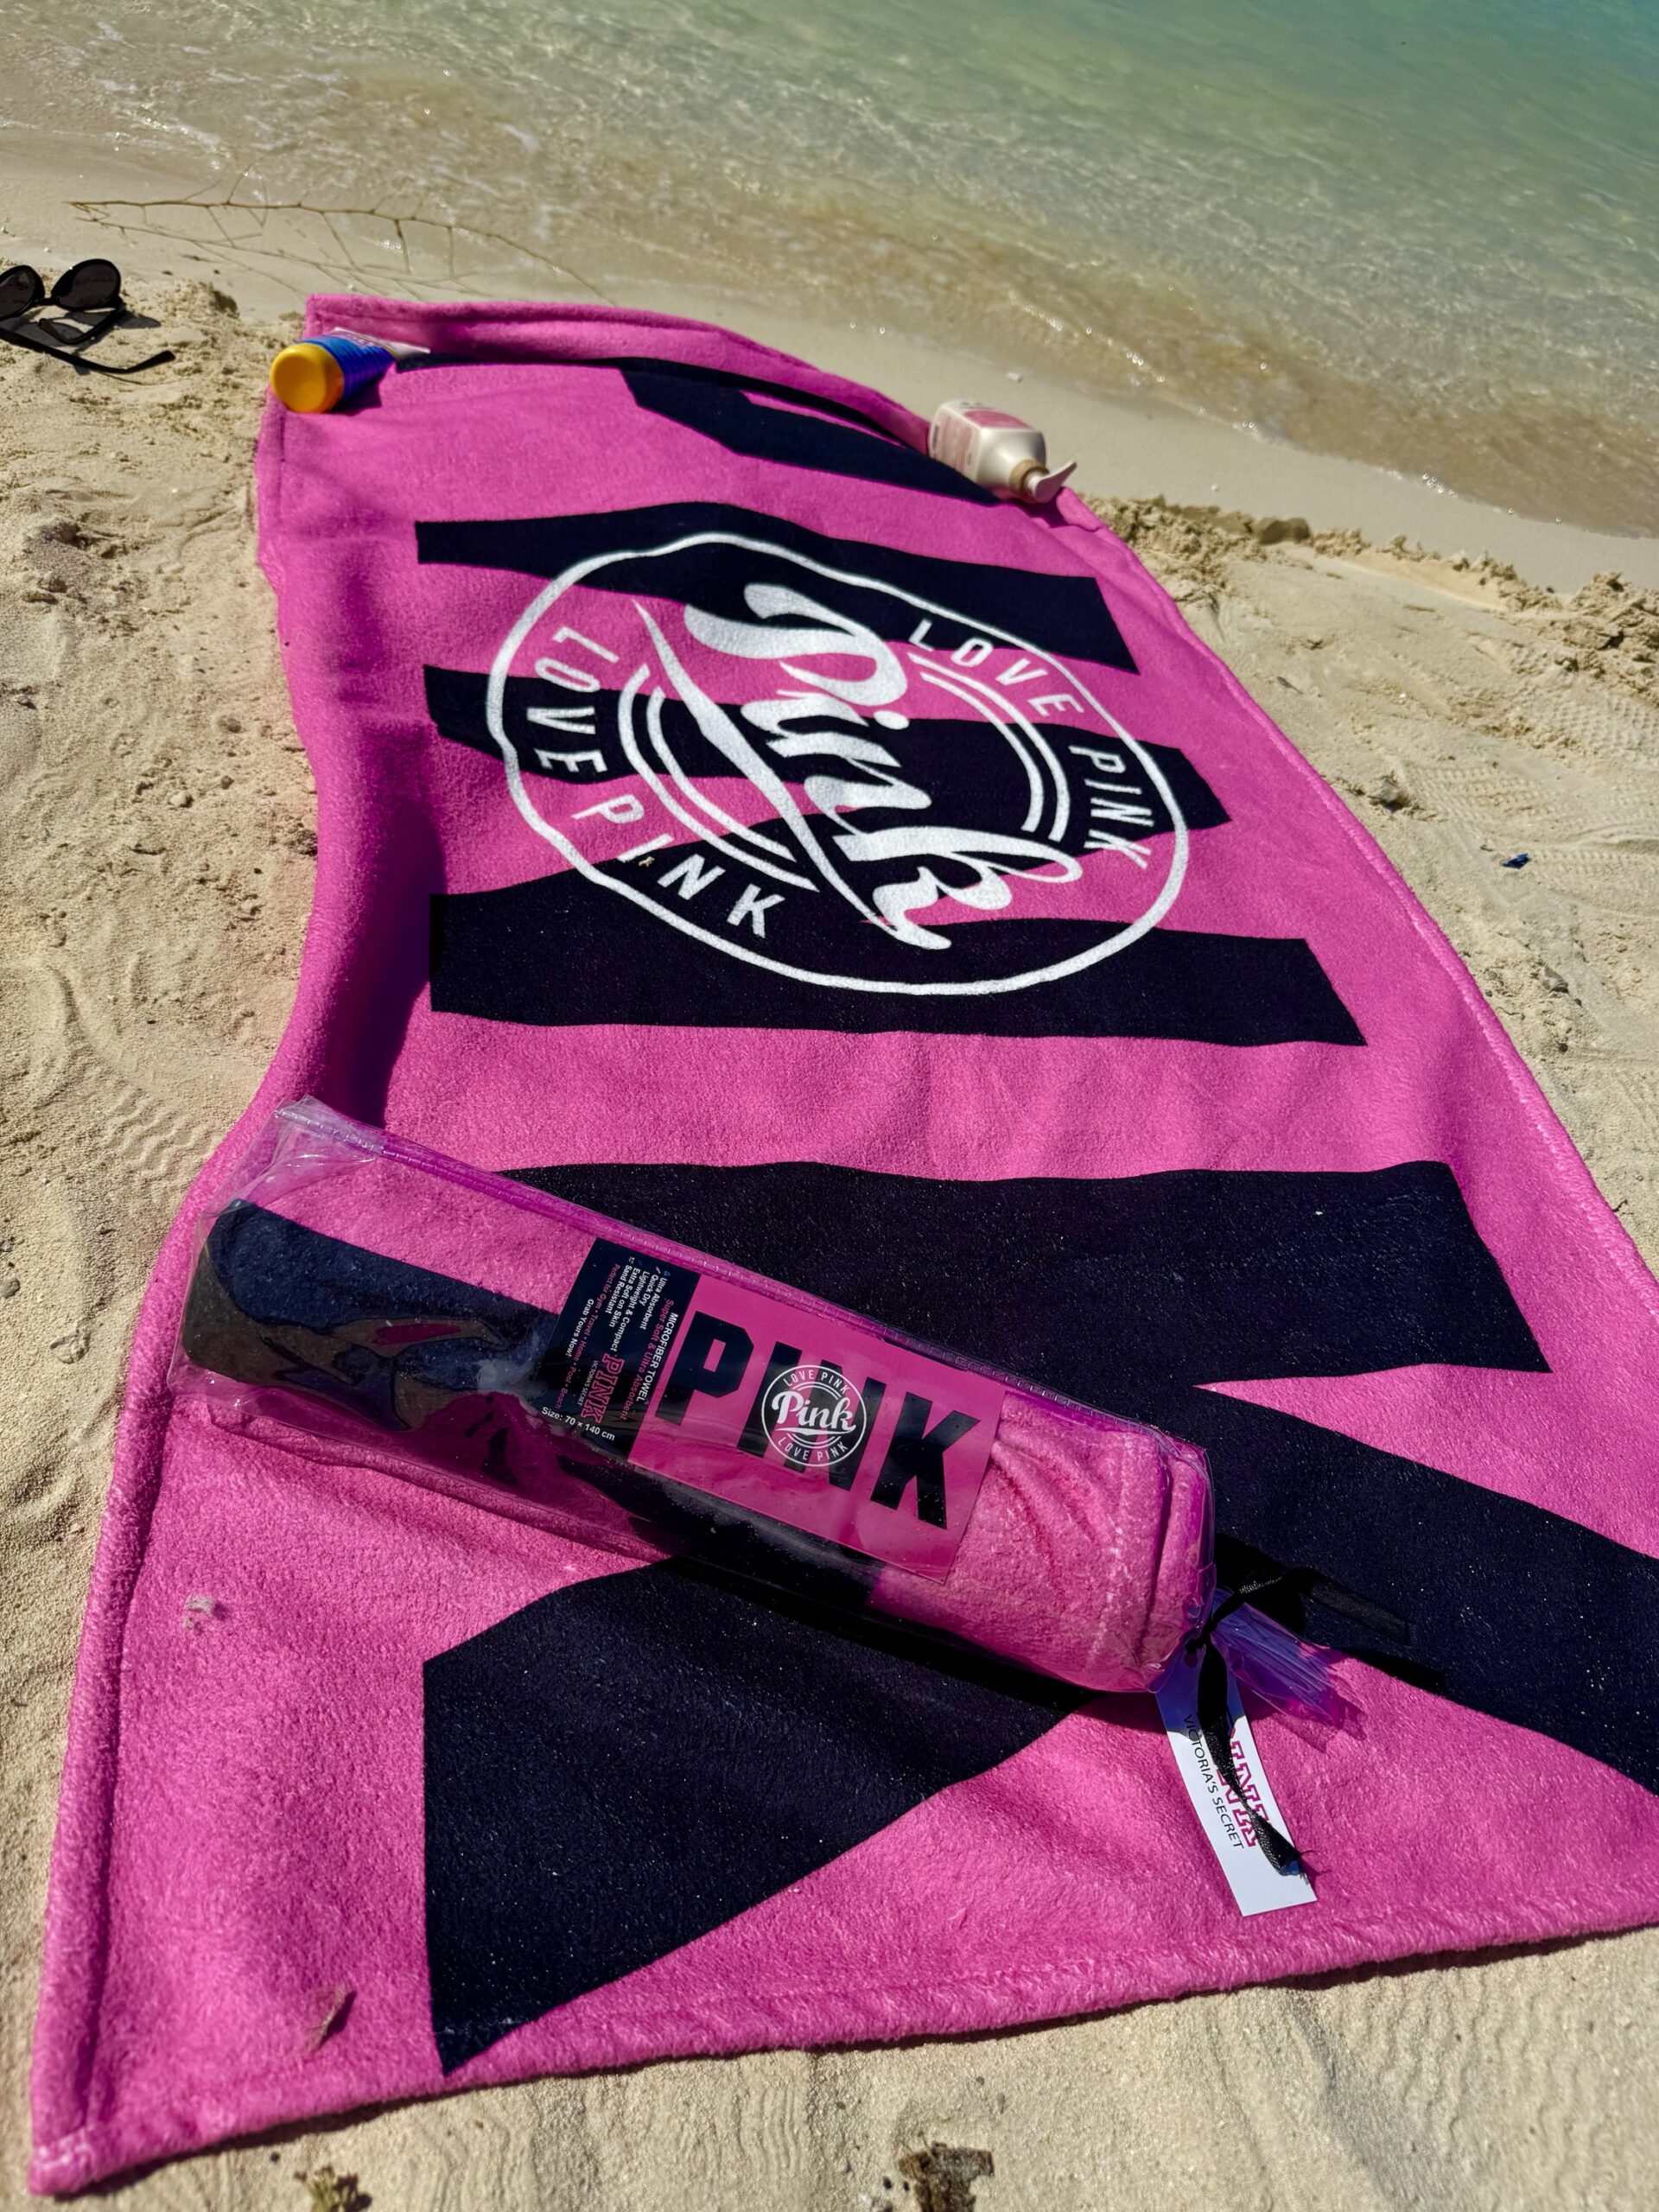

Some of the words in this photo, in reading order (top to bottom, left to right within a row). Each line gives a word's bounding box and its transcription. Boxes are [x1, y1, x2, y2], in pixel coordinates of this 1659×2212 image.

[909, 618, 1084, 717] LOVE
[1068, 743, 1155, 871] PINK
[632, 582, 1083, 950] Pink
[527, 626, 619, 774] LOVE
[573, 793, 785, 938] PINK
[606, 1263, 620, 1284] Perfect
[620, 1264, 632, 1281] Sand
[627, 1267, 640, 1284] Extra
[602, 1283, 611, 1293] for
[620, 1284, 632, 1299] Soft
[627, 1270, 650, 1308] Lightweight
[645, 1274, 658, 1293] Quick
[655, 1277, 667, 1293] Ultra
[582, 1299, 594, 1315] Grab
[594, 1293, 606, 1308] Gym
[605, 1281, 625, 1313] Resistant
[616, 1299, 625, 1309] on
[639, 1293, 651, 1306] Dry
[608, 1310, 621, 1327] Skin
[639, 1292, 659, 1329] Absorbent
[658, 1299, 674, 1322] Super
[573, 1317, 587, 1337] Yours
[583, 1314, 598, 1335] Travel
[610, 1316, 630, 1351] Compact
[651, 1323, 664, 1341] Soft
[565, 1338, 577, 1357] Now!
[573, 1339, 587, 1361] Home
[650, 1312, 678, 1368] MICROFIBER
[638, 1351, 652, 1372] Ultra
[565, 1366, 576, 1382] Pool
[584, 1360, 599, 1387] VICTORIA'S
[783, 1370, 814, 1387] LOVE
[821, 1371, 850, 1394] PINK
[580, 1352, 625, 1423] PINK
[636, 1370, 656, 1401] TOWEL
[555, 1388, 568, 1408] Beach
[577, 1387, 588, 1406] SECRET
[620, 1374, 643, 1420] Absorbent
[541, 1406, 563, 1421] Size:
[564, 1415, 576, 1425] 70
[585, 1424, 601, 1434] 140
[601, 1431, 615, 1441] cm
[655, 1311, 980, 1529] PINK
[772, 1391, 856, 1435] Pink
[778, 1437, 810, 1460] LOVE
[817, 1441, 848, 1461] PINK
[1183, 1713, 1218, 1794] VICTORIA'S
[1212, 1797, 1244, 1849] SECRET
